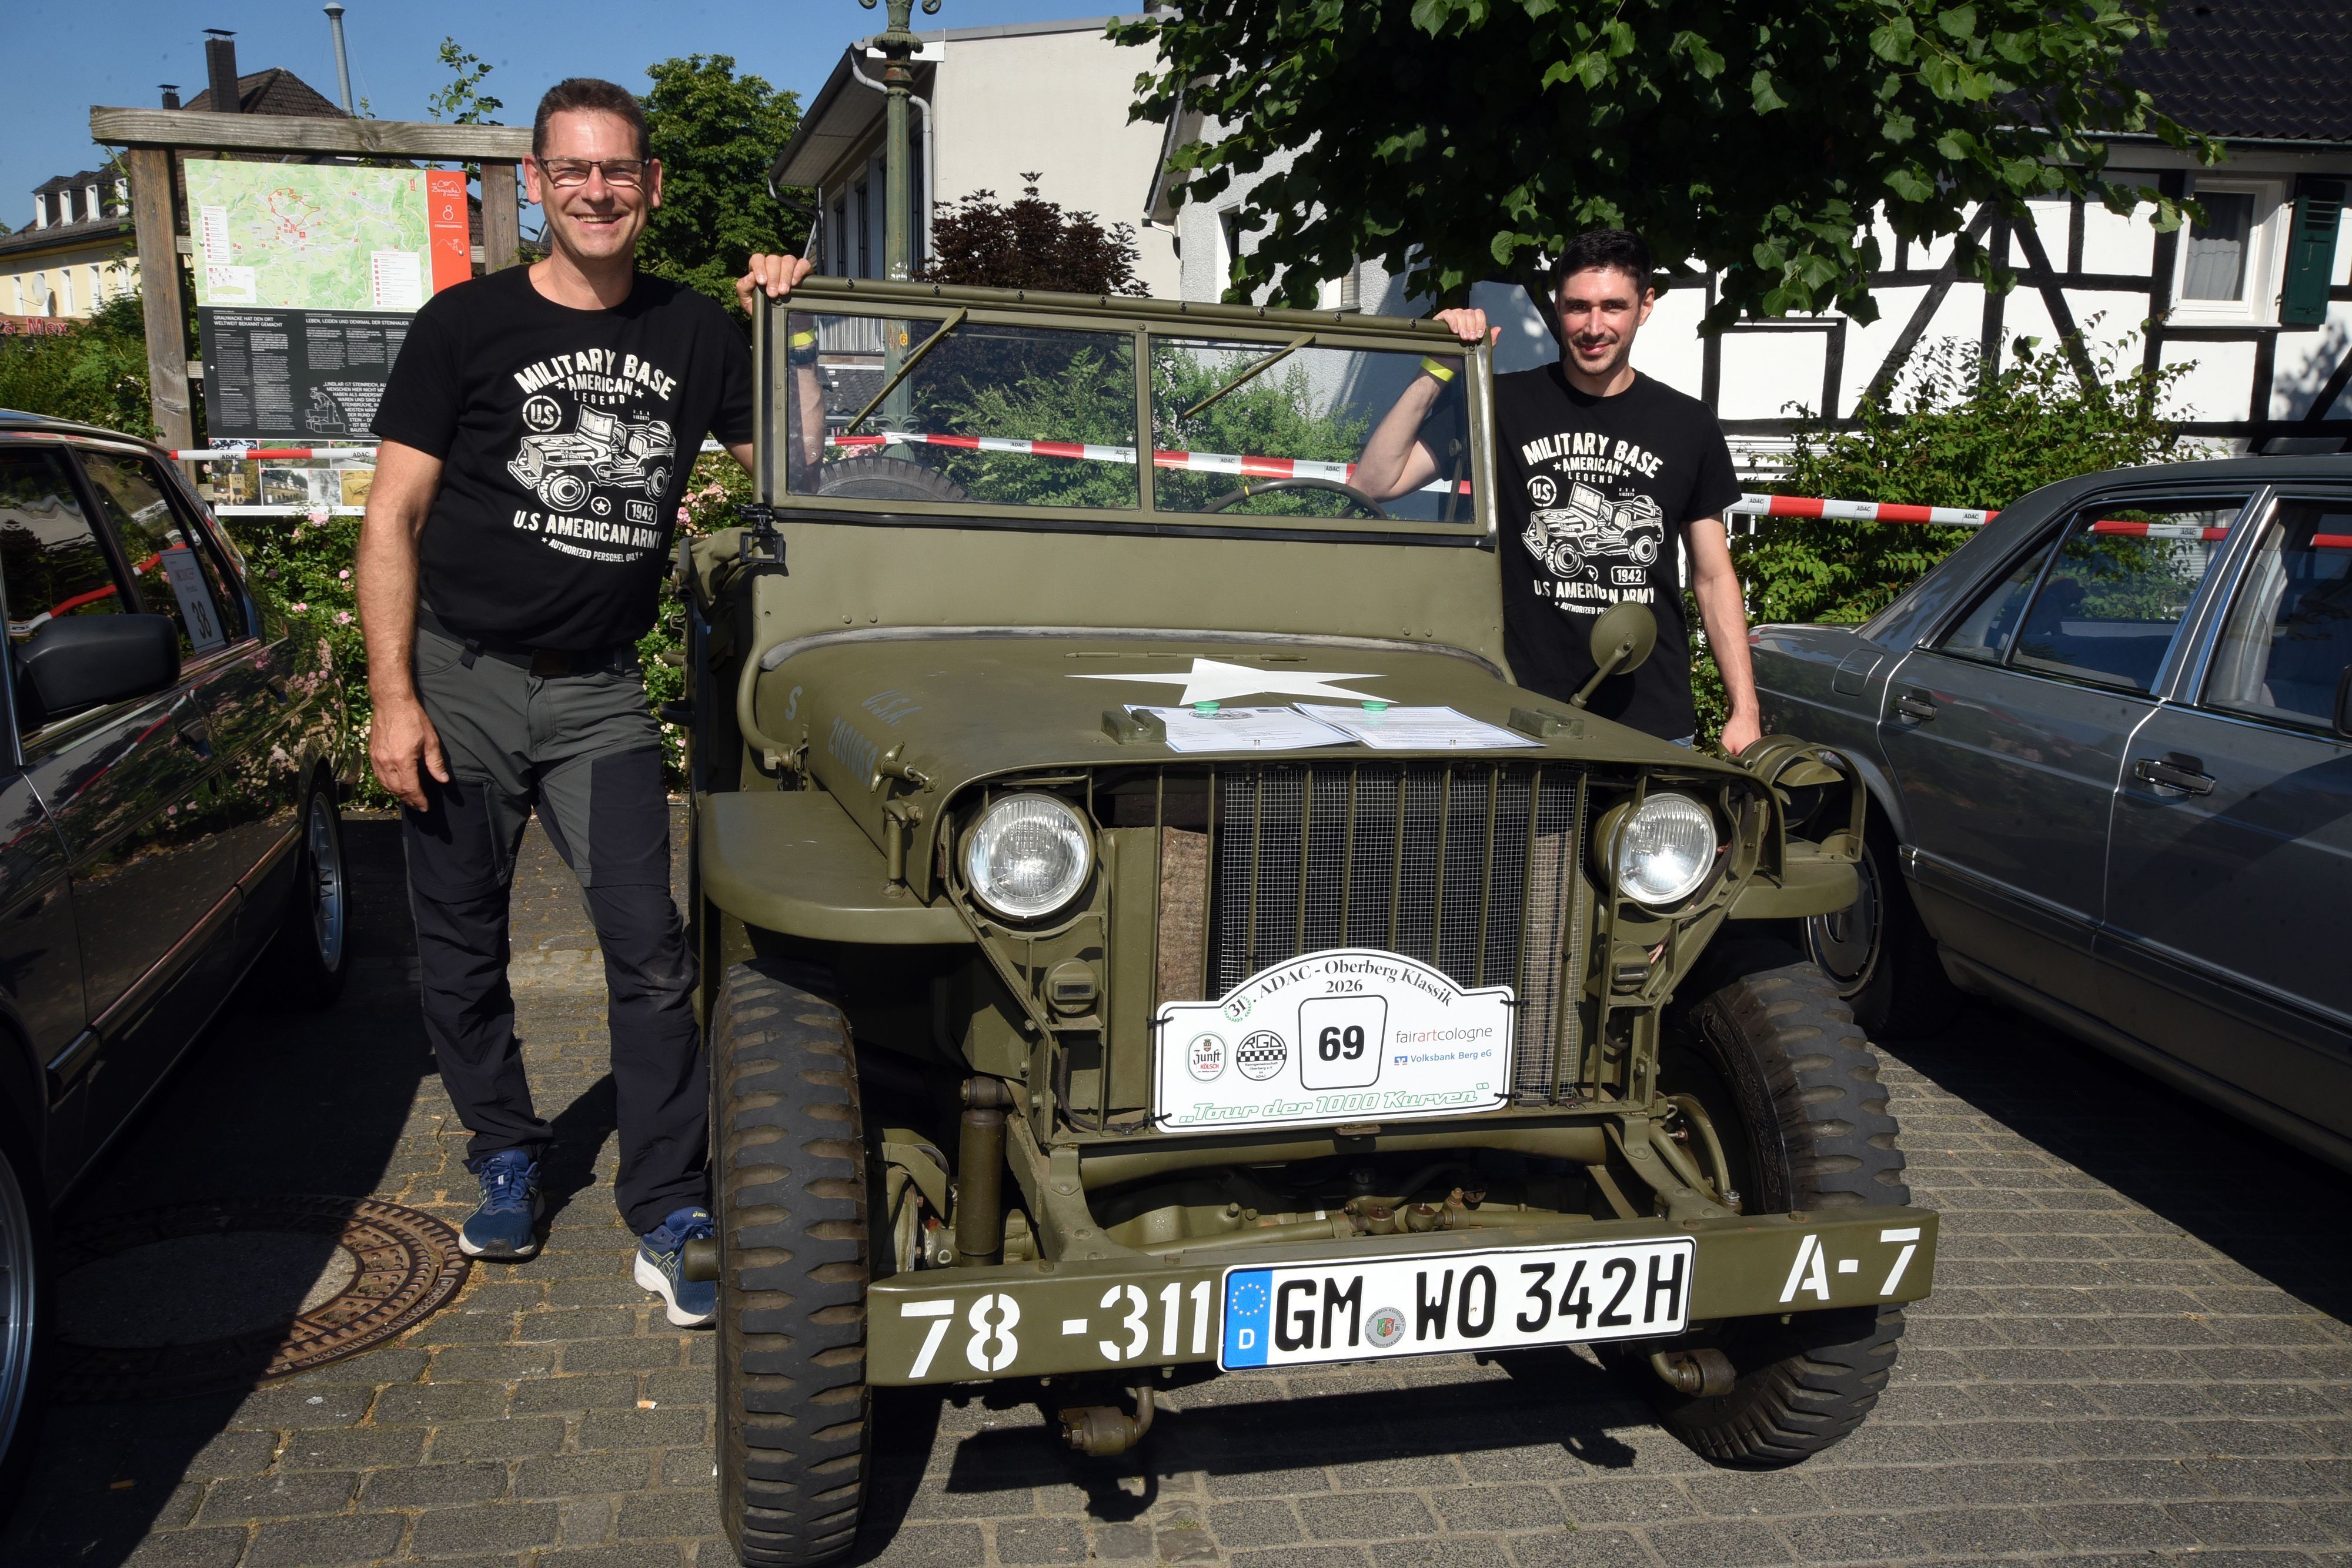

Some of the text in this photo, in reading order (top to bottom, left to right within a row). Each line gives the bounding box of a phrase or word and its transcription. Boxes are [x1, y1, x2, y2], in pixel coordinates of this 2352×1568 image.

[443, 205, 454, 220] 8
[27, 316, 69, 337] Mex
[901, 335, 907, 344] 6
[513, 348, 677, 401] MILITARY BASE
[568, 374, 634, 396] AMERICAN
[574, 392, 625, 405] LEGEND
[1522, 432, 1663, 479] MILITARY BASE
[1562, 457, 1622, 476] AMERICAN
[1568, 472, 1613, 484] LEGEND
[632, 504, 654, 521] 1942
[513, 510, 663, 550] U.S AMERICAN ARMY
[548, 539, 592, 559] AUTHORIZED
[1617, 569, 1642, 582] 1942
[1560, 601, 1595, 615] AUTHORIZED
[191, 600, 212, 640] 38
[1260, 965, 1312, 999] ADAC
[1324, 959, 1398, 983] Oberberg
[1399, 968, 1454, 1007] Klassik
[1325, 979, 1363, 993] 2026
[1318, 1025, 1365, 1061] 69
[1396, 1027, 1493, 1044] fairartcologne
[1411, 1049, 1492, 1063] Volksbank Berg eG
[1262, 1099, 1314, 1117] der
[1315, 1092, 1380, 1114] 1000
[1779, 1227, 1920, 1302] A-7
[1274, 1253, 1685, 1352] GM WO 342H
[900, 1293, 1021, 1378] 78
[1239, 1327, 1255, 1350] D
